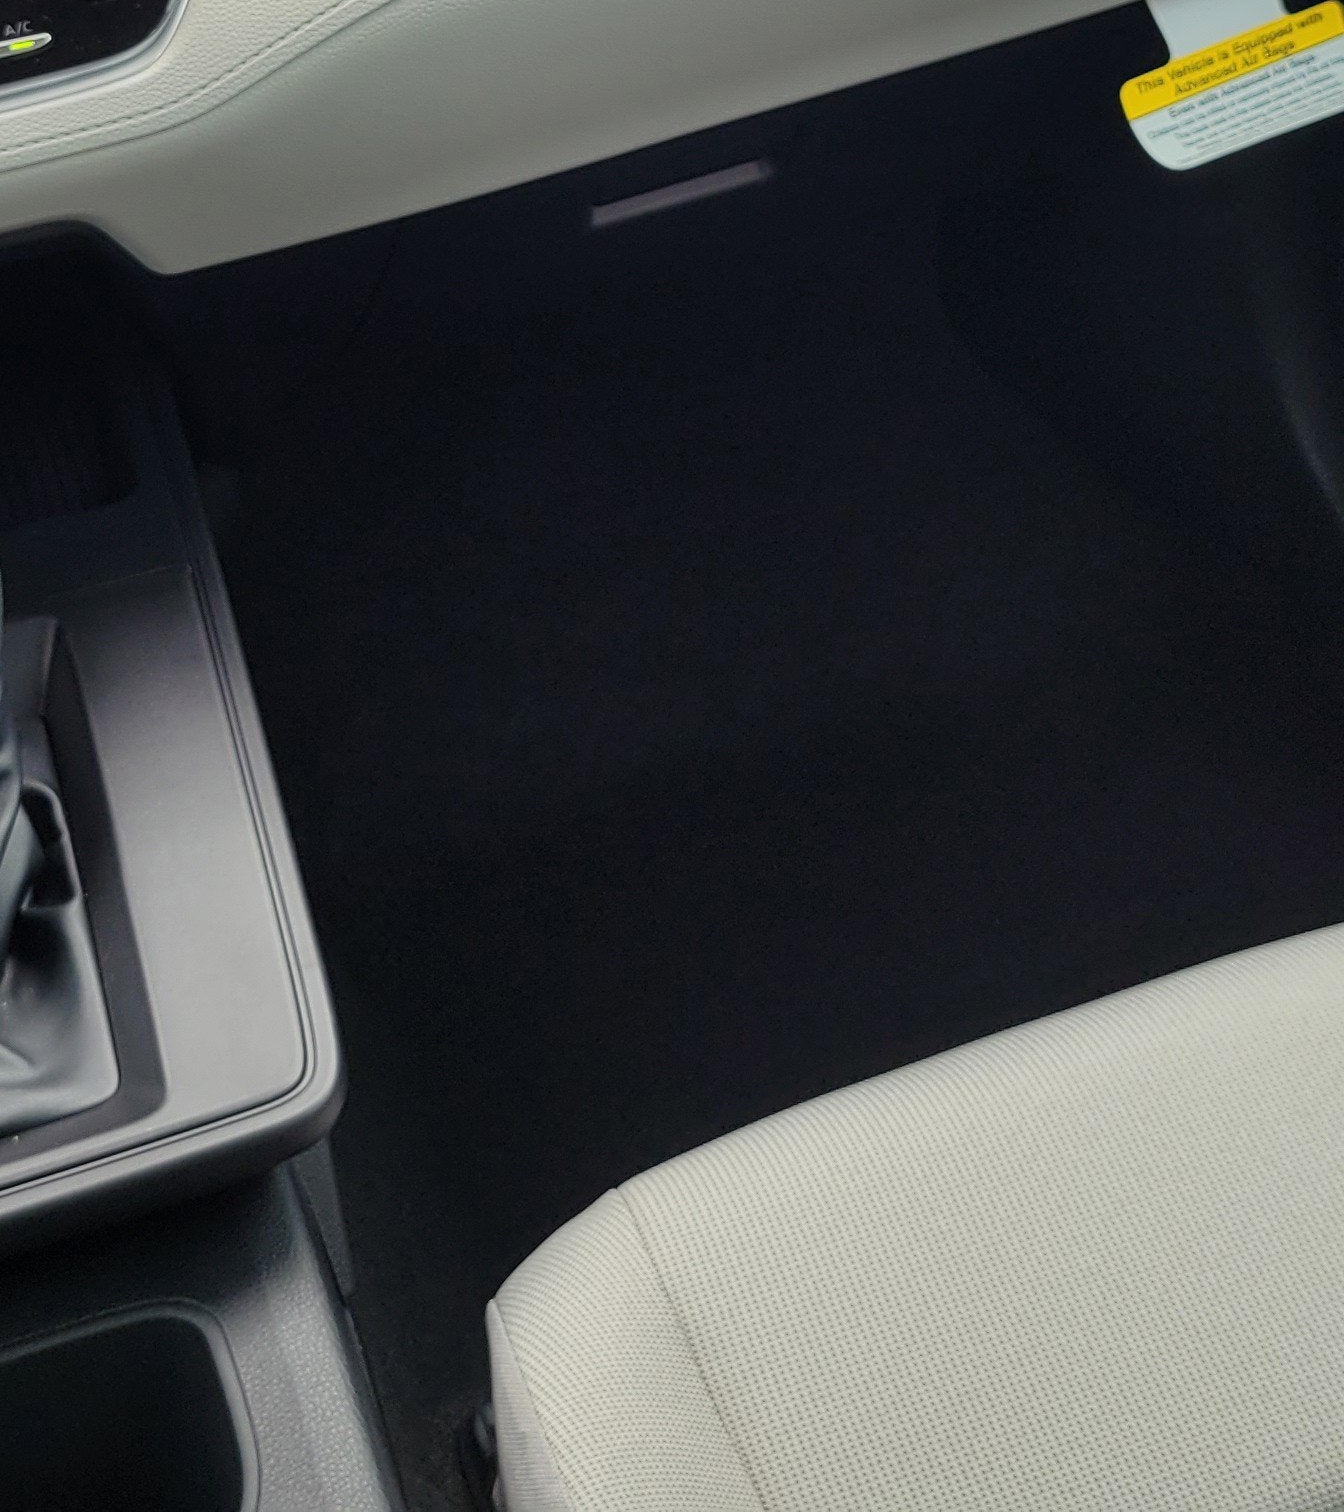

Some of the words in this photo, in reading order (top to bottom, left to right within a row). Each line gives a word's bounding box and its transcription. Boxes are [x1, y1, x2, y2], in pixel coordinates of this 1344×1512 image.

[3, 20, 33, 37] A/C
[1136, 76, 1164, 94] This
[1167, 56, 1215, 81] Vehicle
[1231, 23, 1293, 55] Equipped
